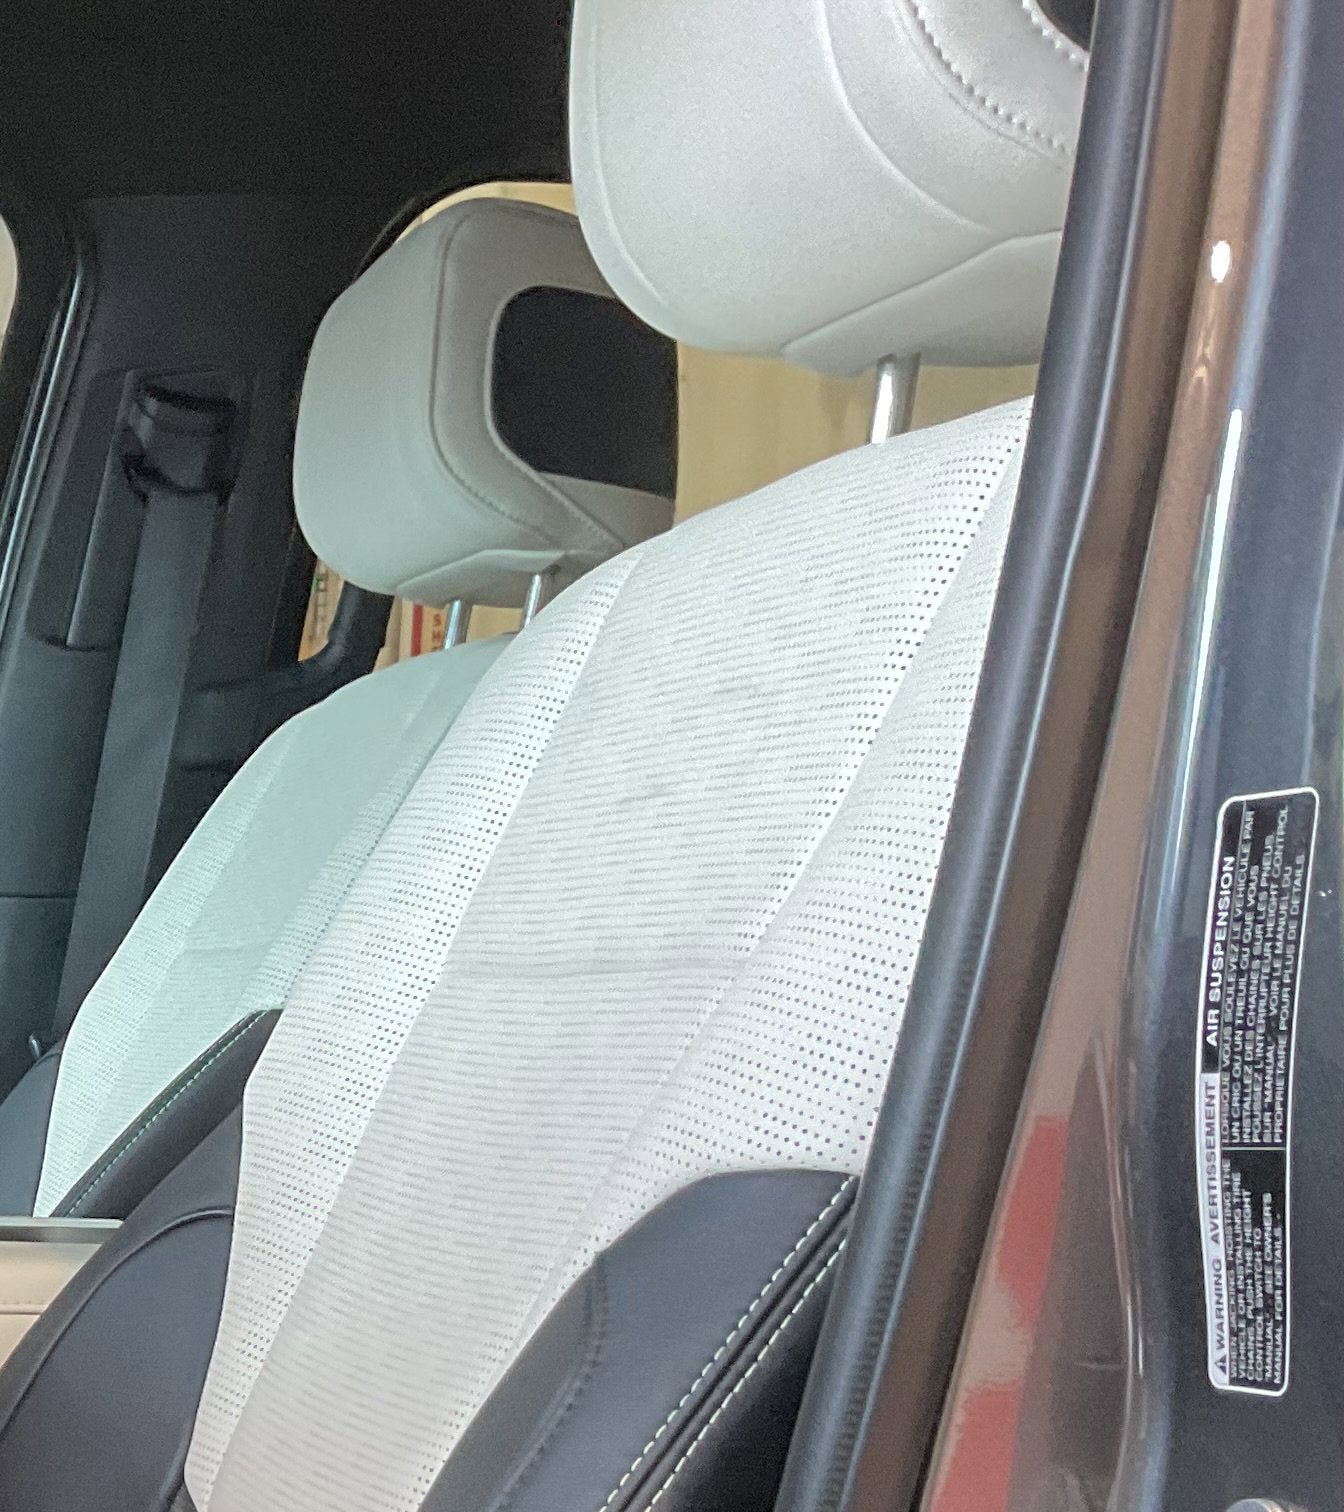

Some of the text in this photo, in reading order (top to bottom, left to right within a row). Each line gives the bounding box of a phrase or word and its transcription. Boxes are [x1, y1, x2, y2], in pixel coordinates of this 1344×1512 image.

[1243, 810, 1255, 839] PAR
[1271, 805, 1288, 878] CONTROL
[1281, 866, 1292, 887] DU
[1256, 891, 1268, 919] LES
[1266, 883, 1279, 937] HEIGHT
[1274, 893, 1289, 953] MANUEL
[1206, 856, 1234, 1047] AIR SUSPENSION
[1252, 924, 1264, 955] SUR
[1288, 920, 1297, 940] DE
[1223, 944, 1240, 1022] SOULEVEZ
[1272, 958, 1282, 976] LE
[1283, 944, 1296, 984] PLUS
[1232, 865, 1259, 1142] UN CRIC OU UN TREUIL OU QUE VOUS
[1268, 981, 1279, 1016] VOIR
[1278, 987, 1291, 1030] POUR
[1222, 1026, 1232, 1067] VOUS
[1244, 1030, 1254, 1061] DES
[1242, 1064, 1252, 1142] INSTALLEZ
[1252, 1072, 1262, 1142] POUSSEZ
[1263, 1112, 1272, 1142] SUR
[1232, 1172, 1241, 1203] TIRE
[1204, 1081, 1225, 1351] WARNING AVERTISSEMENT
[1223, 1192, 1233, 1260] HOISTING
[1242, 1189, 1252, 1243] HEIGHT
[1233, 1208, 1244, 1289] INSTALLING
[1245, 1248, 1253, 1274] THE
[1238, 1294, 1245, 1314] OR
[1253, 1228, 1263, 1381] CONTROL SWITCH TO
[1274, 1324, 1282, 1383] MANUAL
